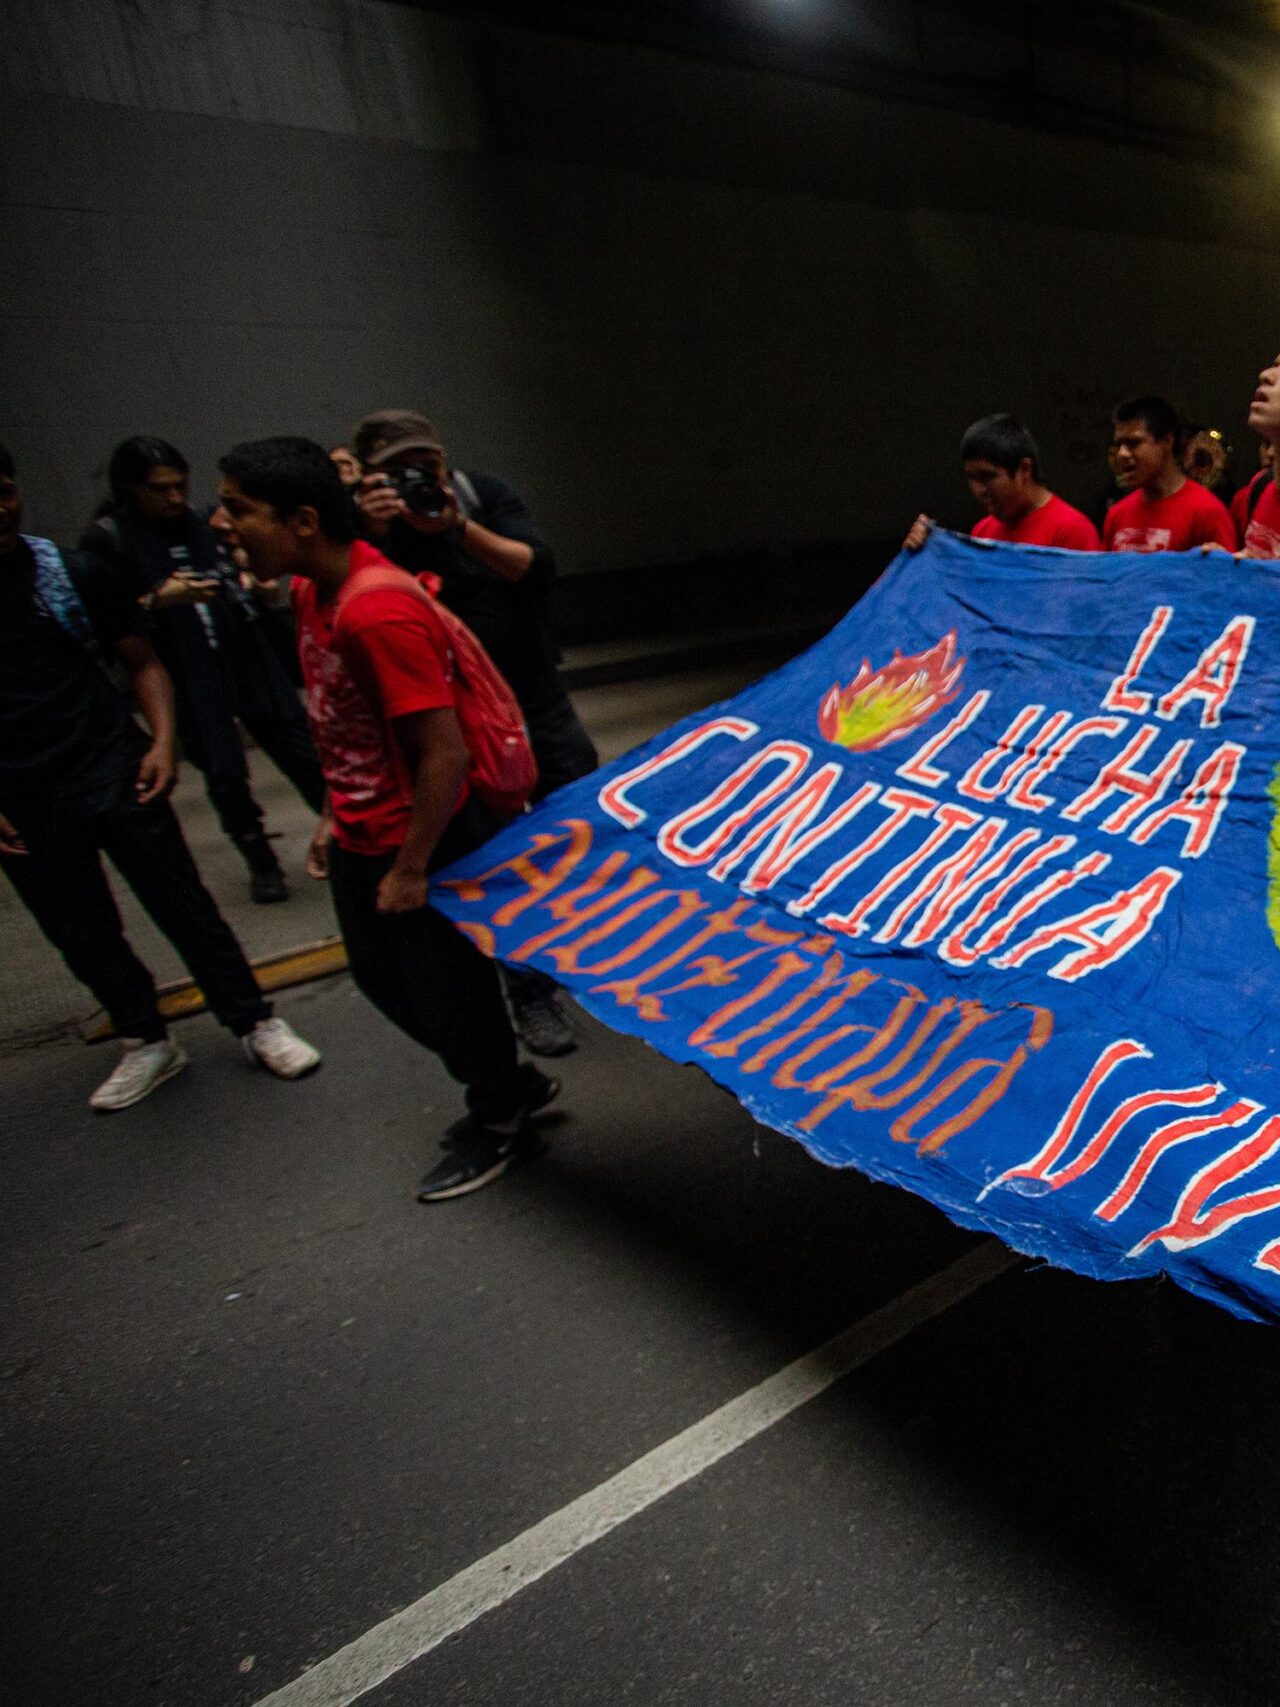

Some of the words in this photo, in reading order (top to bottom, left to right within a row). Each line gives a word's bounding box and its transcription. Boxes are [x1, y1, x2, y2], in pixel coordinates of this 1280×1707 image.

[1106, 605, 1257, 728] LA
[598, 715, 1184, 983] CONTINUA
[896, 690, 1248, 859] LUCHA
